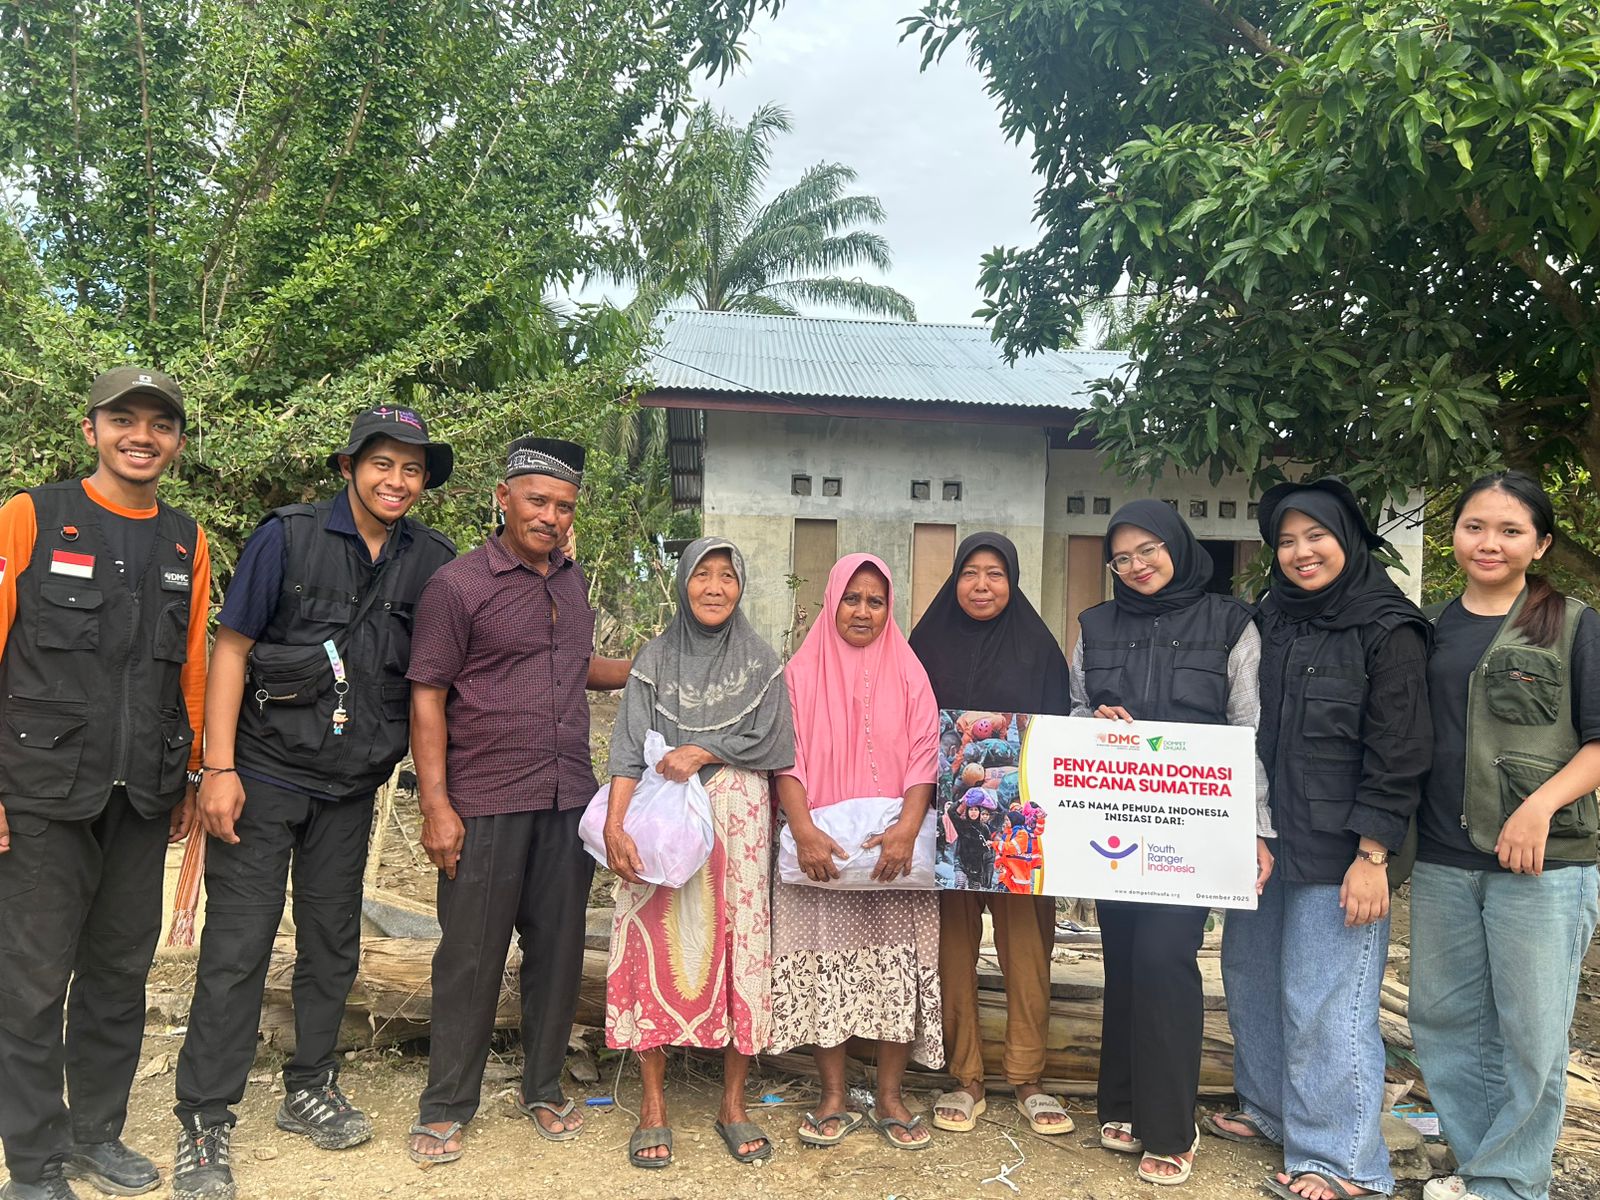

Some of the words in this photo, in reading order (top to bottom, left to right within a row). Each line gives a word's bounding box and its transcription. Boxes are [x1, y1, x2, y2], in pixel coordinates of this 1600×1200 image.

[1108, 733, 1140, 746] DMC
[1053, 757, 1163, 777] PENYALURAN
[1167, 764, 1232, 781] DONASI
[1053, 773, 1136, 792] BENCANA
[1139, 779, 1232, 797] SUMATERA
[1058, 800, 1086, 809] ATAS
[1088, 801, 1119, 811] NAMA
[1122, 803, 1165, 814] PEMUDA
[1168, 806, 1229, 818] INDONESIA
[1105, 813, 1152, 824] INISIASI
[1155, 817, 1185, 826] DARI:
[1147, 843, 1176, 854] Youth
[1147, 853, 1184, 865] Ranger
[1147, 863, 1196, 874] Indonesia
[1195, 893, 1231, 901] Desember
